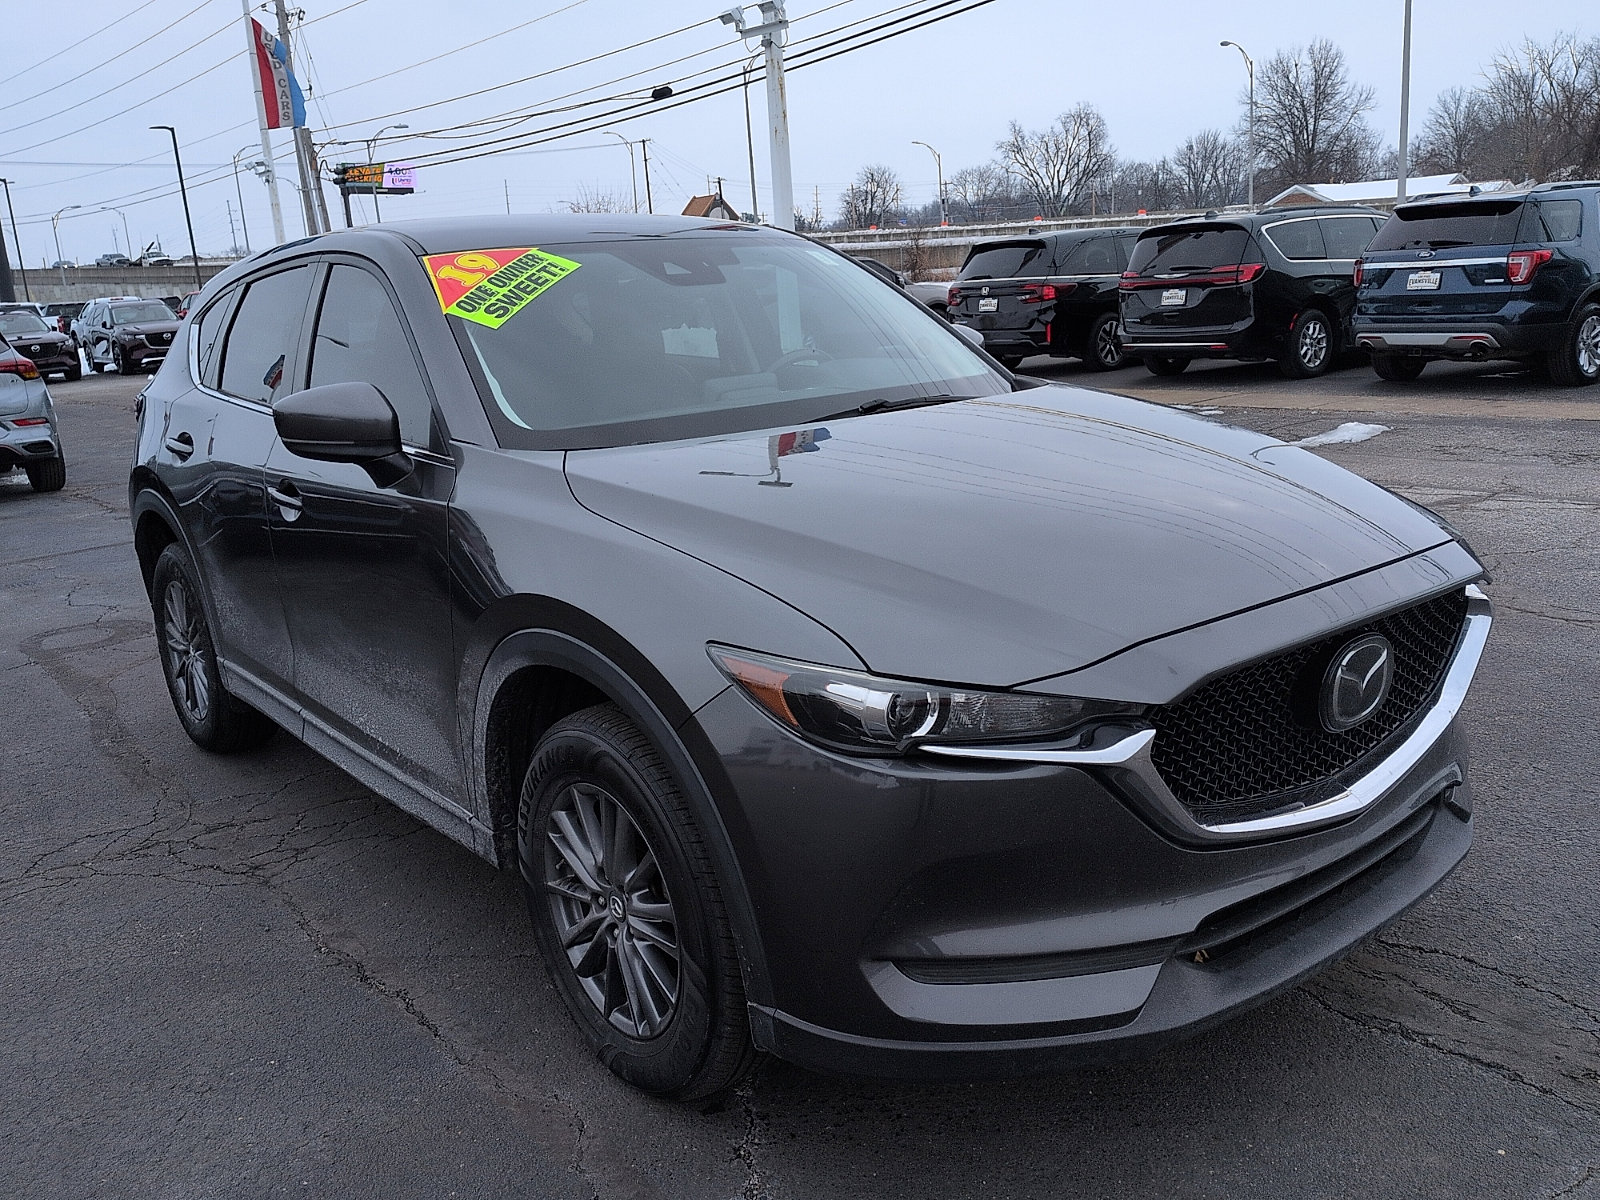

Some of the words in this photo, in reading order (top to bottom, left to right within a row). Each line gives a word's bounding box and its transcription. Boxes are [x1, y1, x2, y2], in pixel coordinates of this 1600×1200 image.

[278, 79, 290, 120] CARS
[436, 252, 501, 287] 19
[455, 284, 499, 314] ONE
[486, 253, 546, 290] OWNER
[484, 261, 570, 319] SWEET!
[1408, 277, 1438, 286] EVANSVILLE
